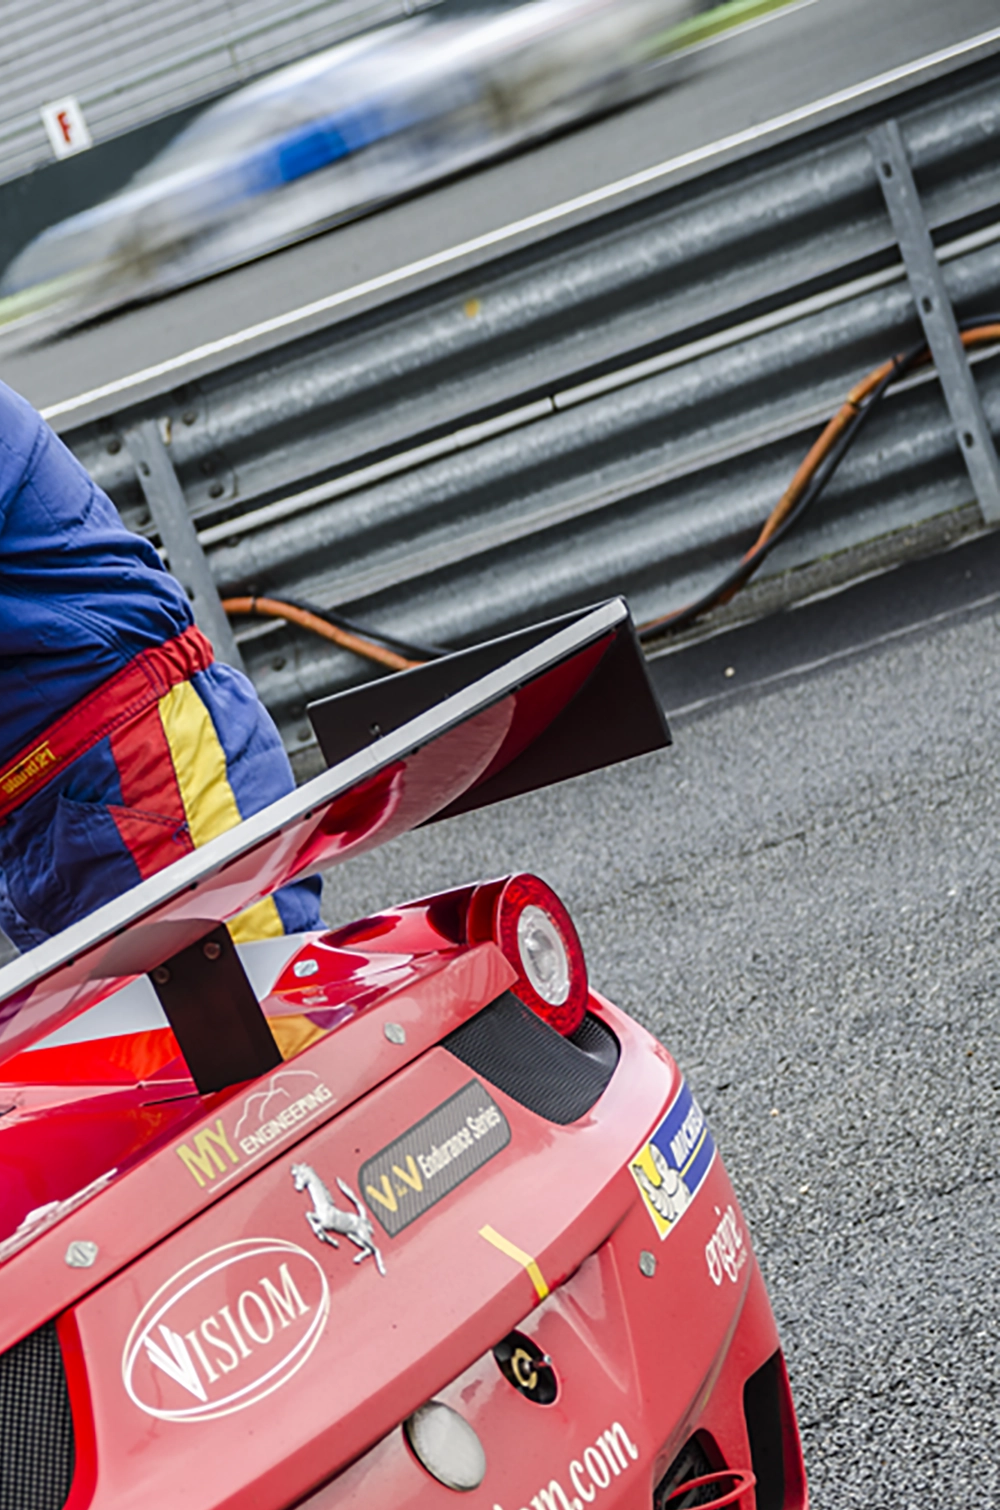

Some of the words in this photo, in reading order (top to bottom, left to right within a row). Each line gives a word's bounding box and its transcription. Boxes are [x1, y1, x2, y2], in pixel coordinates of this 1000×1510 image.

[57, 111, 71, 142] F
[175, 1119, 240, 1188] MY
[239, 1084, 333, 1156] ENGINEERING
[417, 1127, 475, 1179] Endurance
[468, 1104, 501, 1140] Series
[144, 1263, 310, 1402] VISIOM
